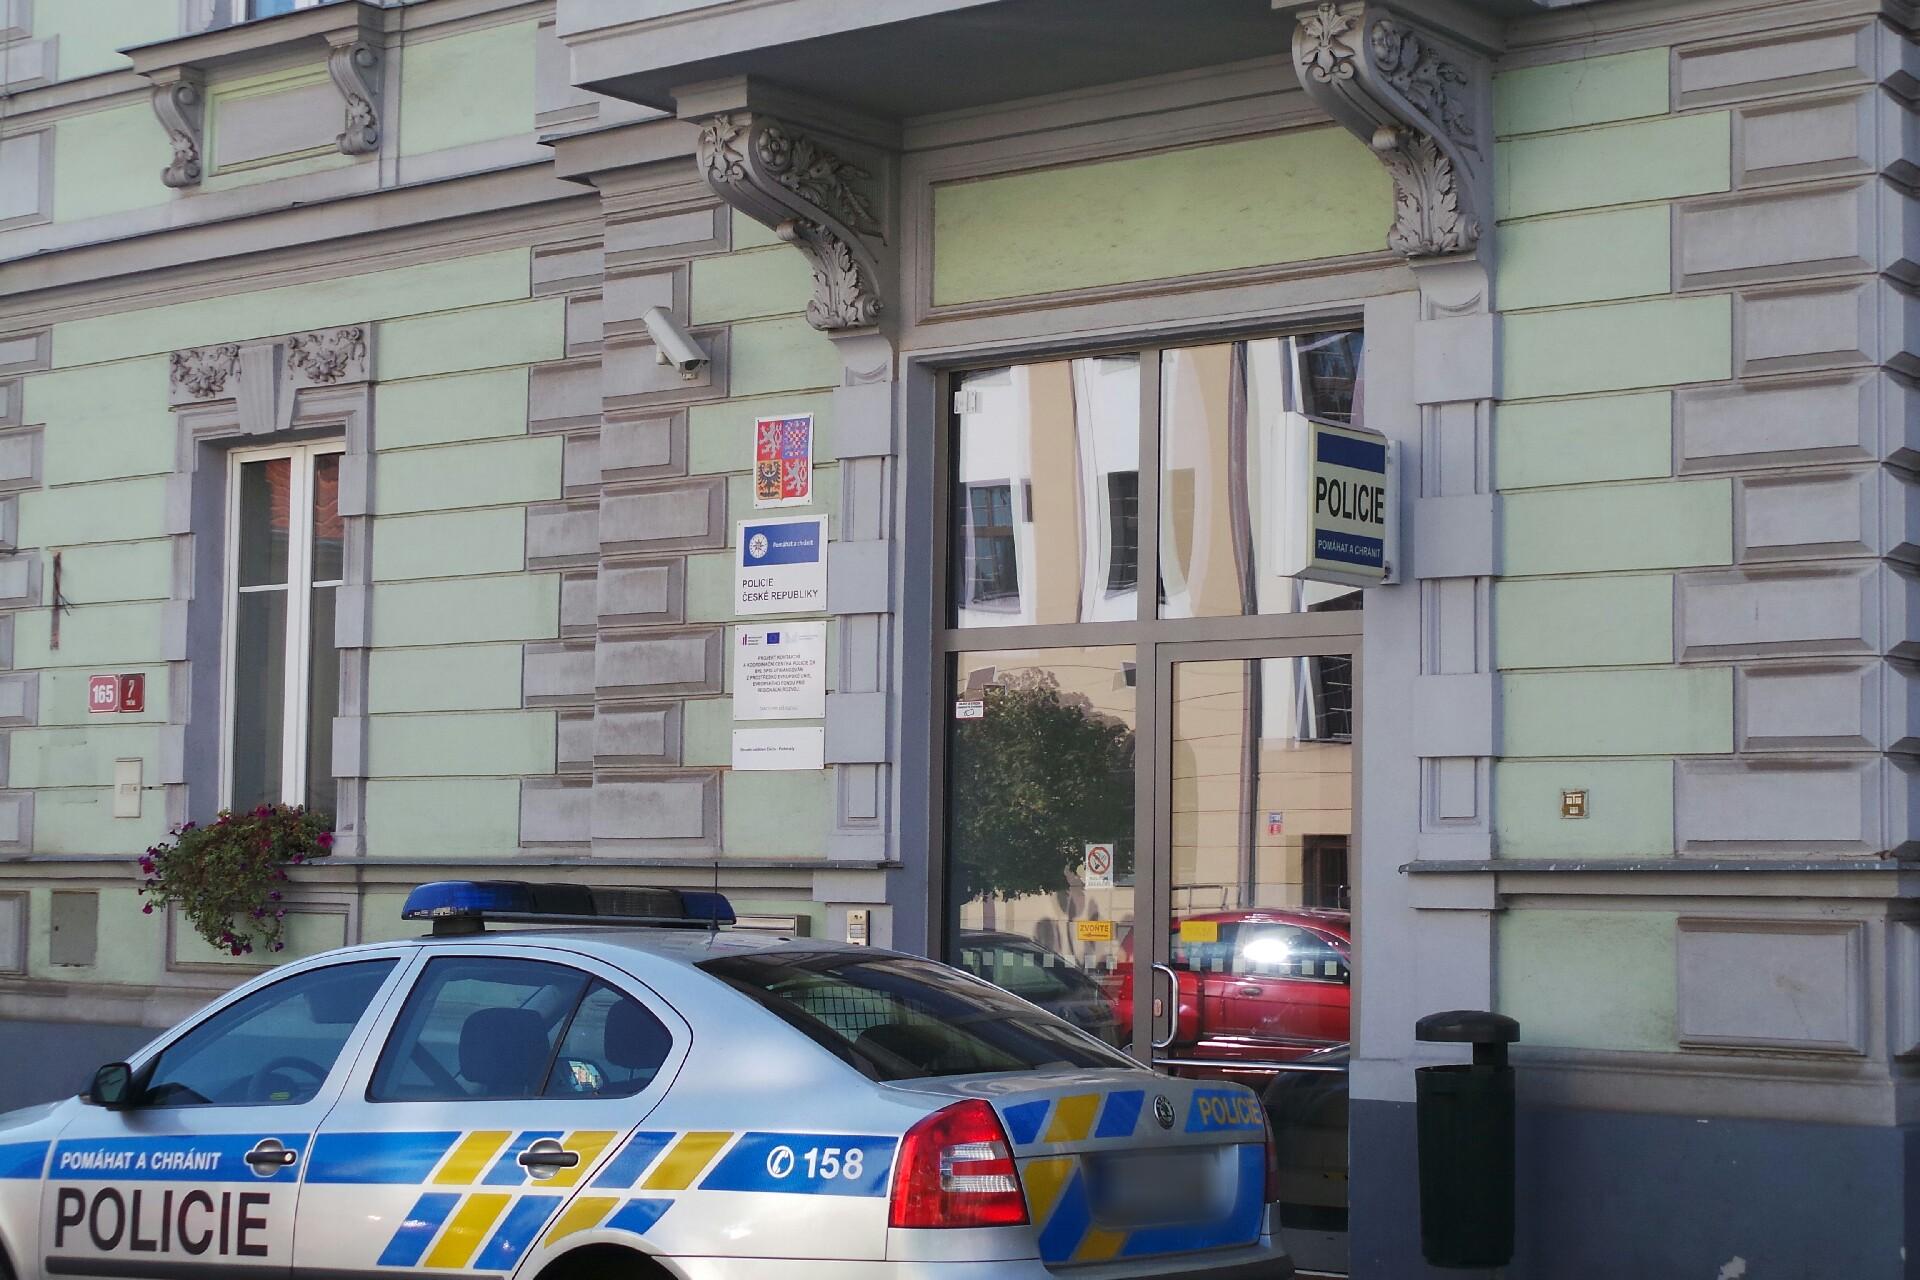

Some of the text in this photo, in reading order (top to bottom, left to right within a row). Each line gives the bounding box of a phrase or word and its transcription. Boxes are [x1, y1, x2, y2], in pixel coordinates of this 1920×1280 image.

[1316, 476, 1384, 524] POLICIE
[1317, 539, 1348, 553] POMÁHAT
[742, 578, 774, 588] POLICIE
[742, 589, 818, 602] ČESKÉ REPUBLIKY
[92, 684, 114, 704] 165
[1198, 1096, 1264, 1125] POLICIE
[59, 1146, 223, 1171] POMÁHAT A CHRÁNIT
[803, 1147, 864, 1180] 158
[54, 1186, 271, 1257] POLICIE
